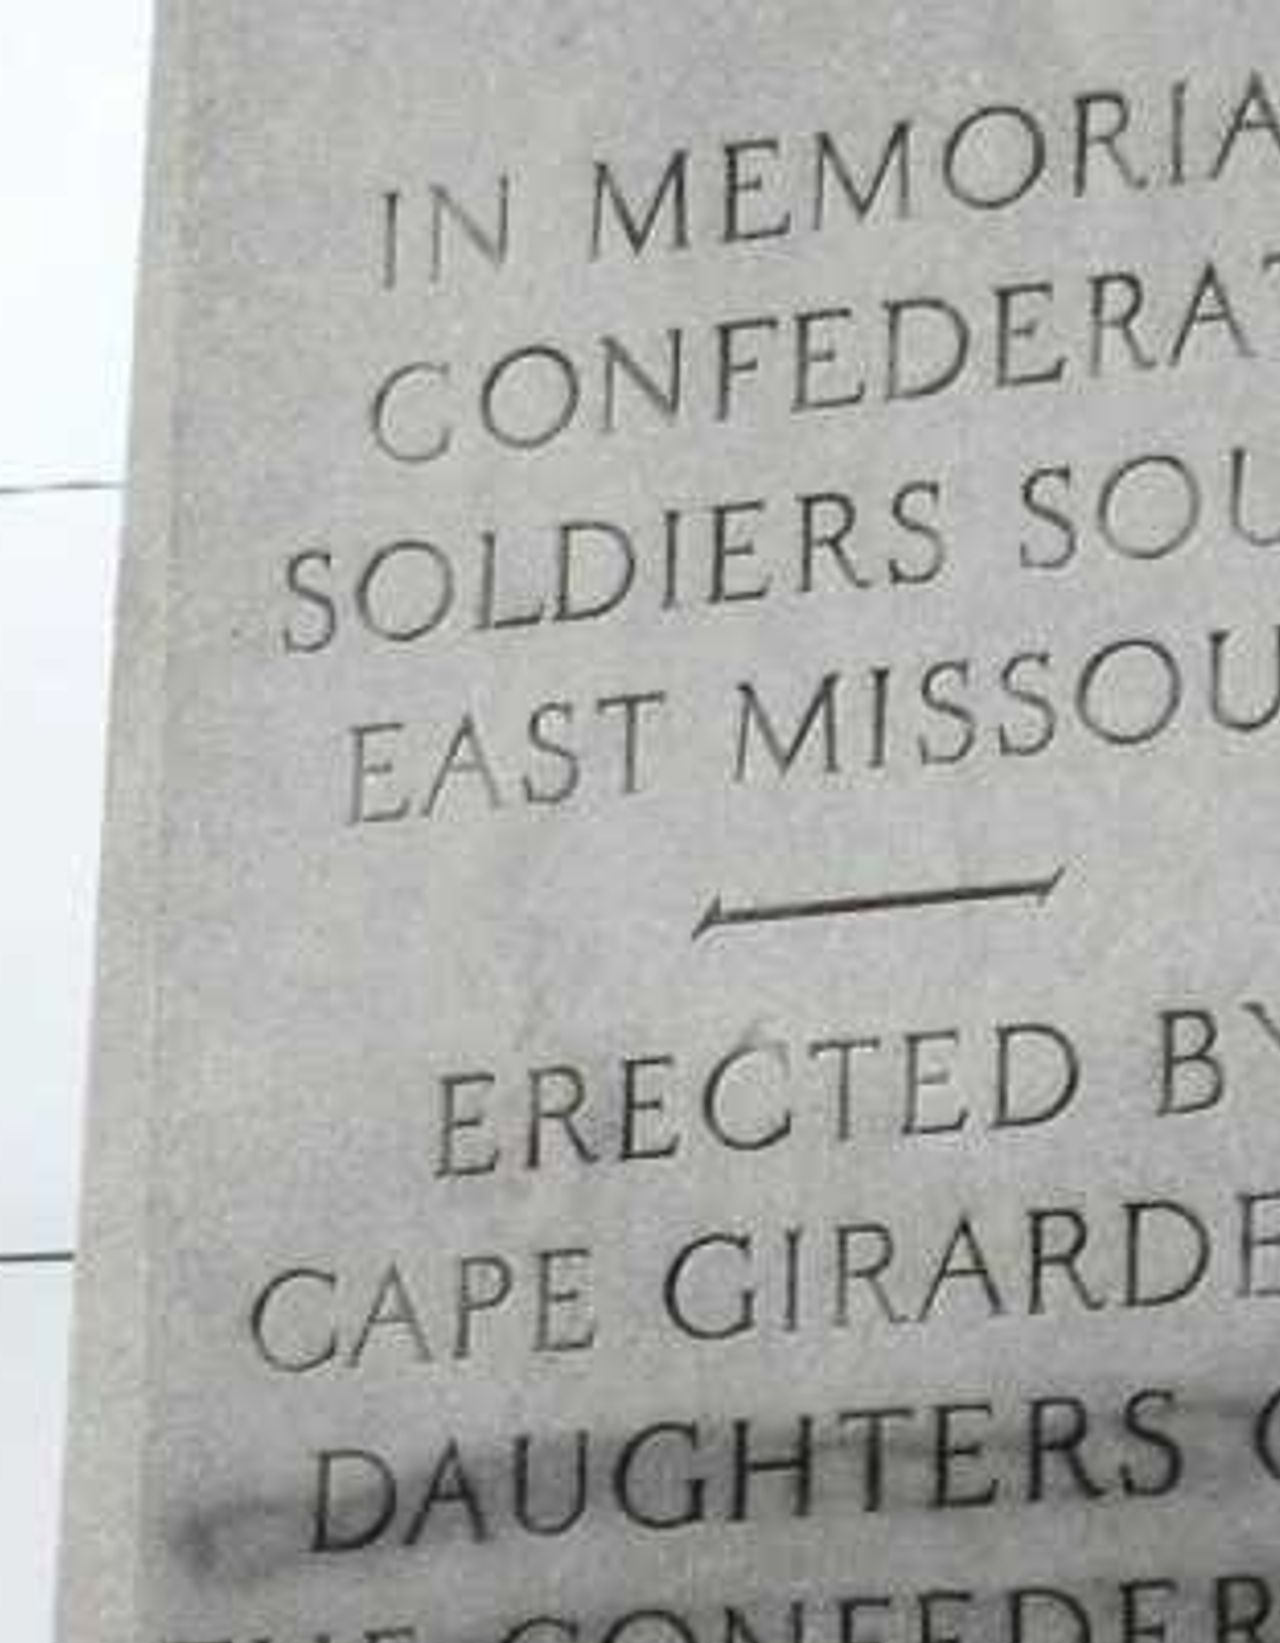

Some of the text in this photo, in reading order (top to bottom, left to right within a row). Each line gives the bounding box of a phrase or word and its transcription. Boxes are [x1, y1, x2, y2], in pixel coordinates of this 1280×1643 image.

[377, 172, 510, 290] IN
[282, 479, 948, 656] SOLDIERS
[345, 690, 670, 825] EAST
[430, 1021, 1083, 1179] ERECTED
[247, 1246, 600, 1375] CAPE
[305, 1385, 1186, 1558] DAUGHTERS
